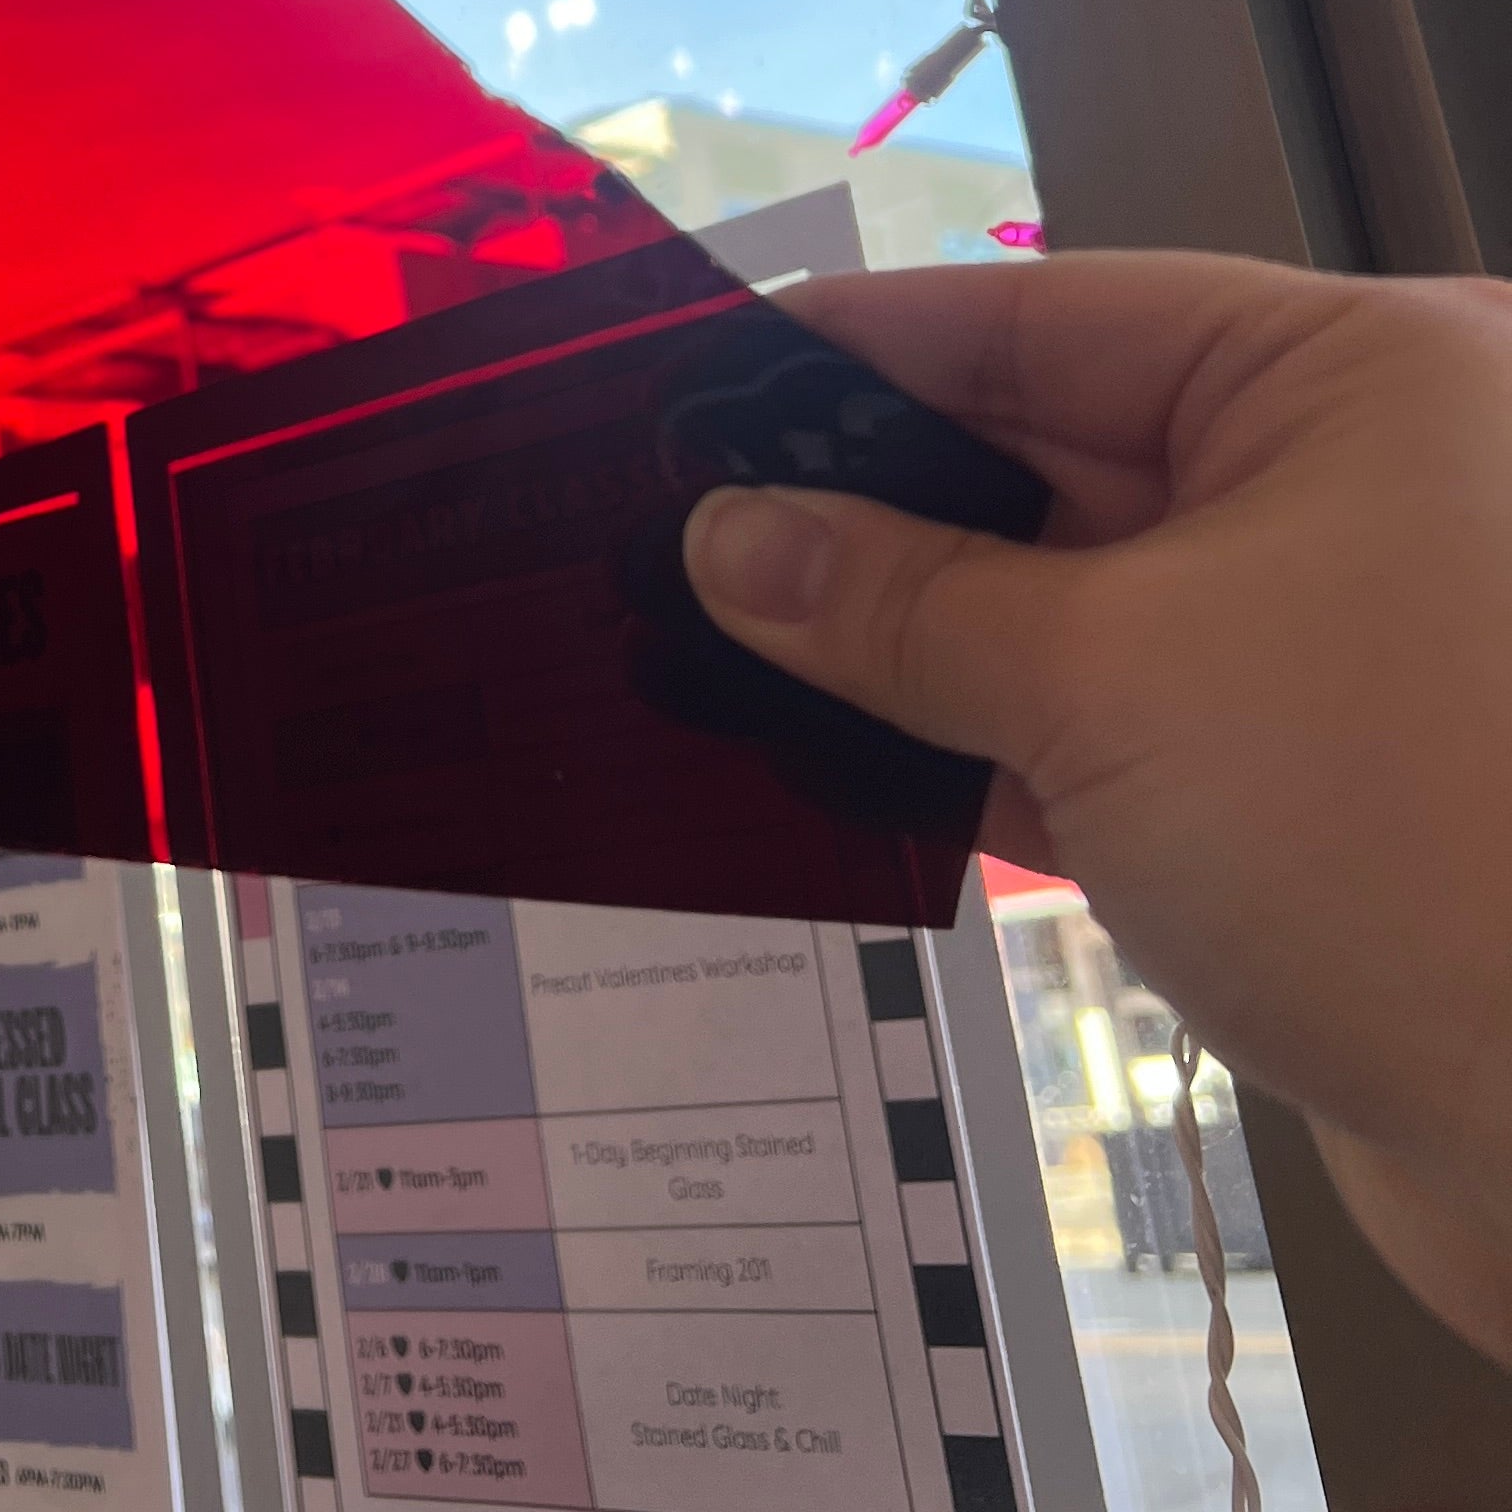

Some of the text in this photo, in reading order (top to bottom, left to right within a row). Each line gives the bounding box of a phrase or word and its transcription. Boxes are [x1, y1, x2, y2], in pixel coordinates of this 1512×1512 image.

[593, 960, 699, 991] Valentines
[701, 949, 809, 979] Workshop
[14, 1070, 99, 1136] CLASS
[631, 1136, 734, 1167] Beginning
[735, 1129, 818, 1159] Stained
[667, 1173, 726, 1202] Glass
[645, 1255, 774, 1288] Framing 201
[665, 1379, 717, 1408] Date
[629, 1418, 844, 1456] Stained Glass & Chill
